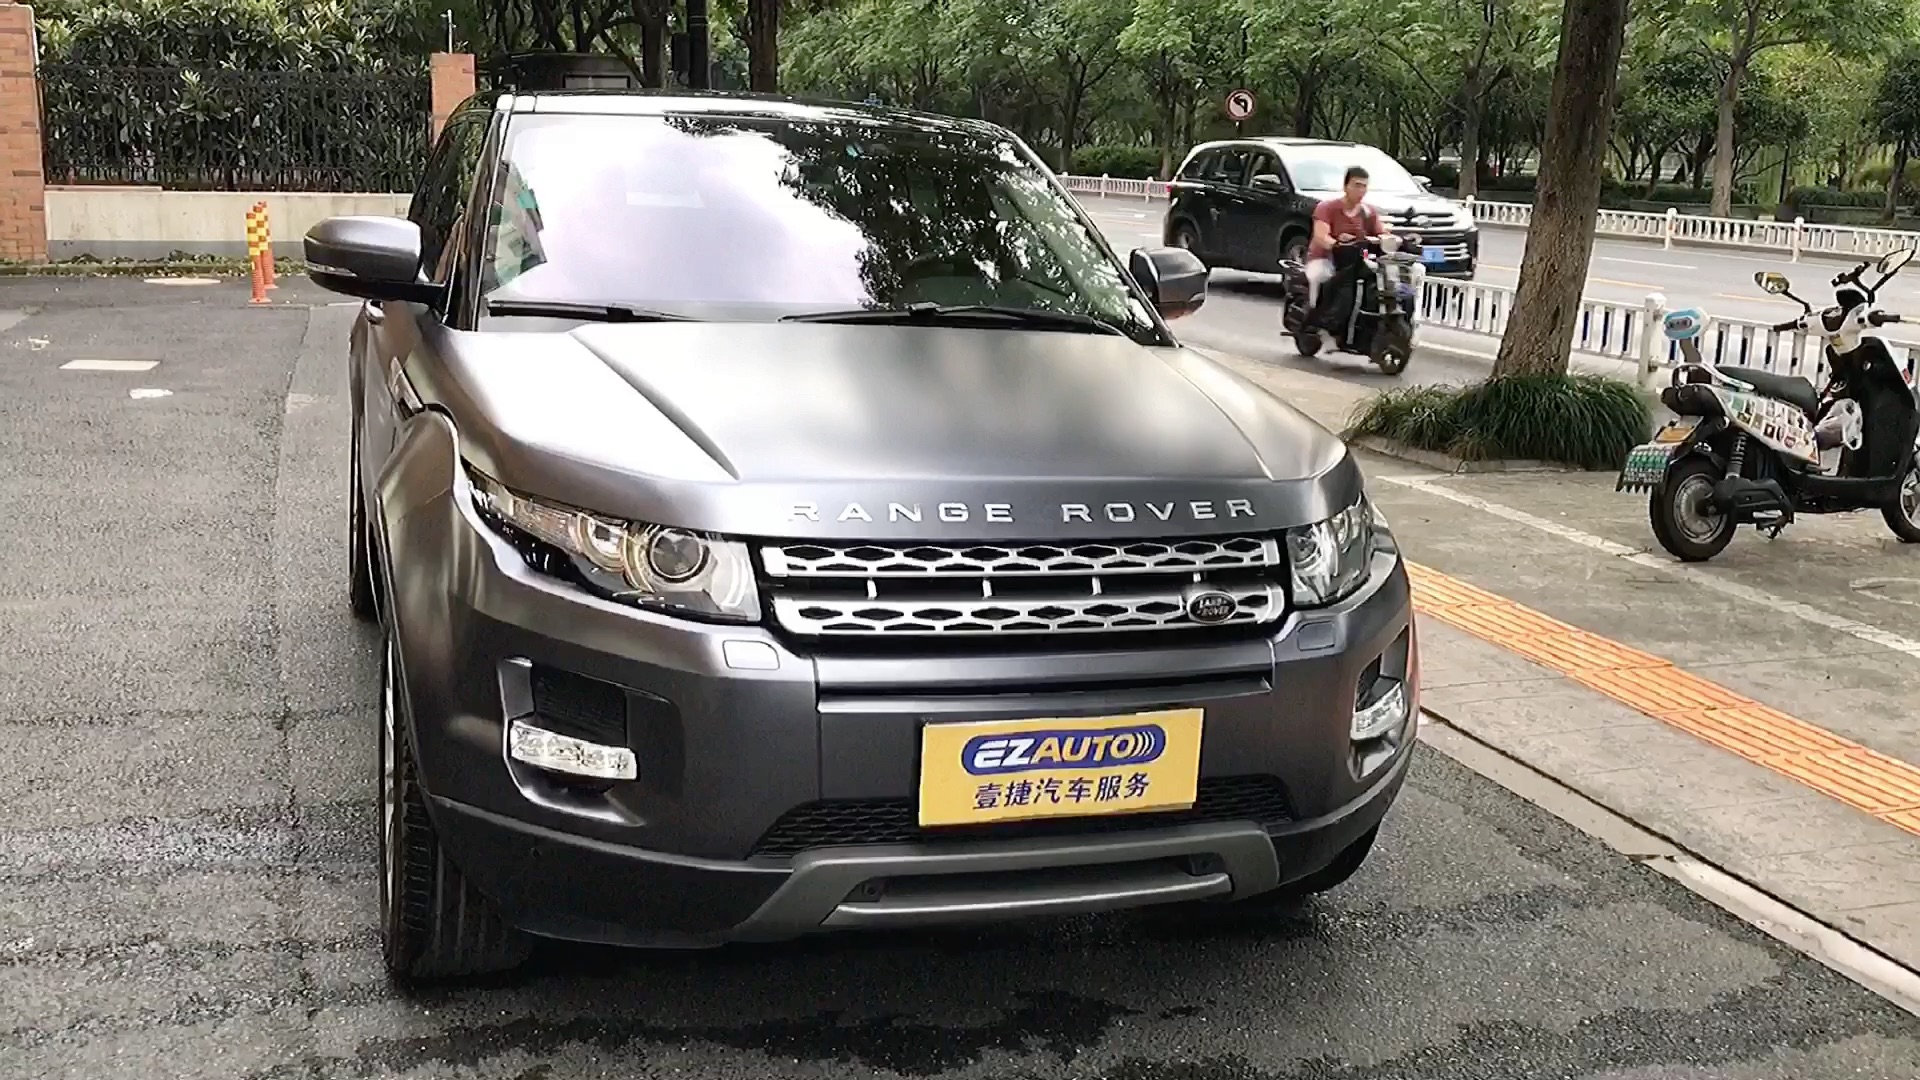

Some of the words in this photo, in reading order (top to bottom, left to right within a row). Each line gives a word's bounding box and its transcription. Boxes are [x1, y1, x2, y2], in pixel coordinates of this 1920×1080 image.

[786, 501, 1014, 522] RANGE
[1060, 499, 1256, 522] ROVER
[974, 734, 1133, 768] EZAUTO
[974, 773, 1149, 809] 壹捷汽车服务
